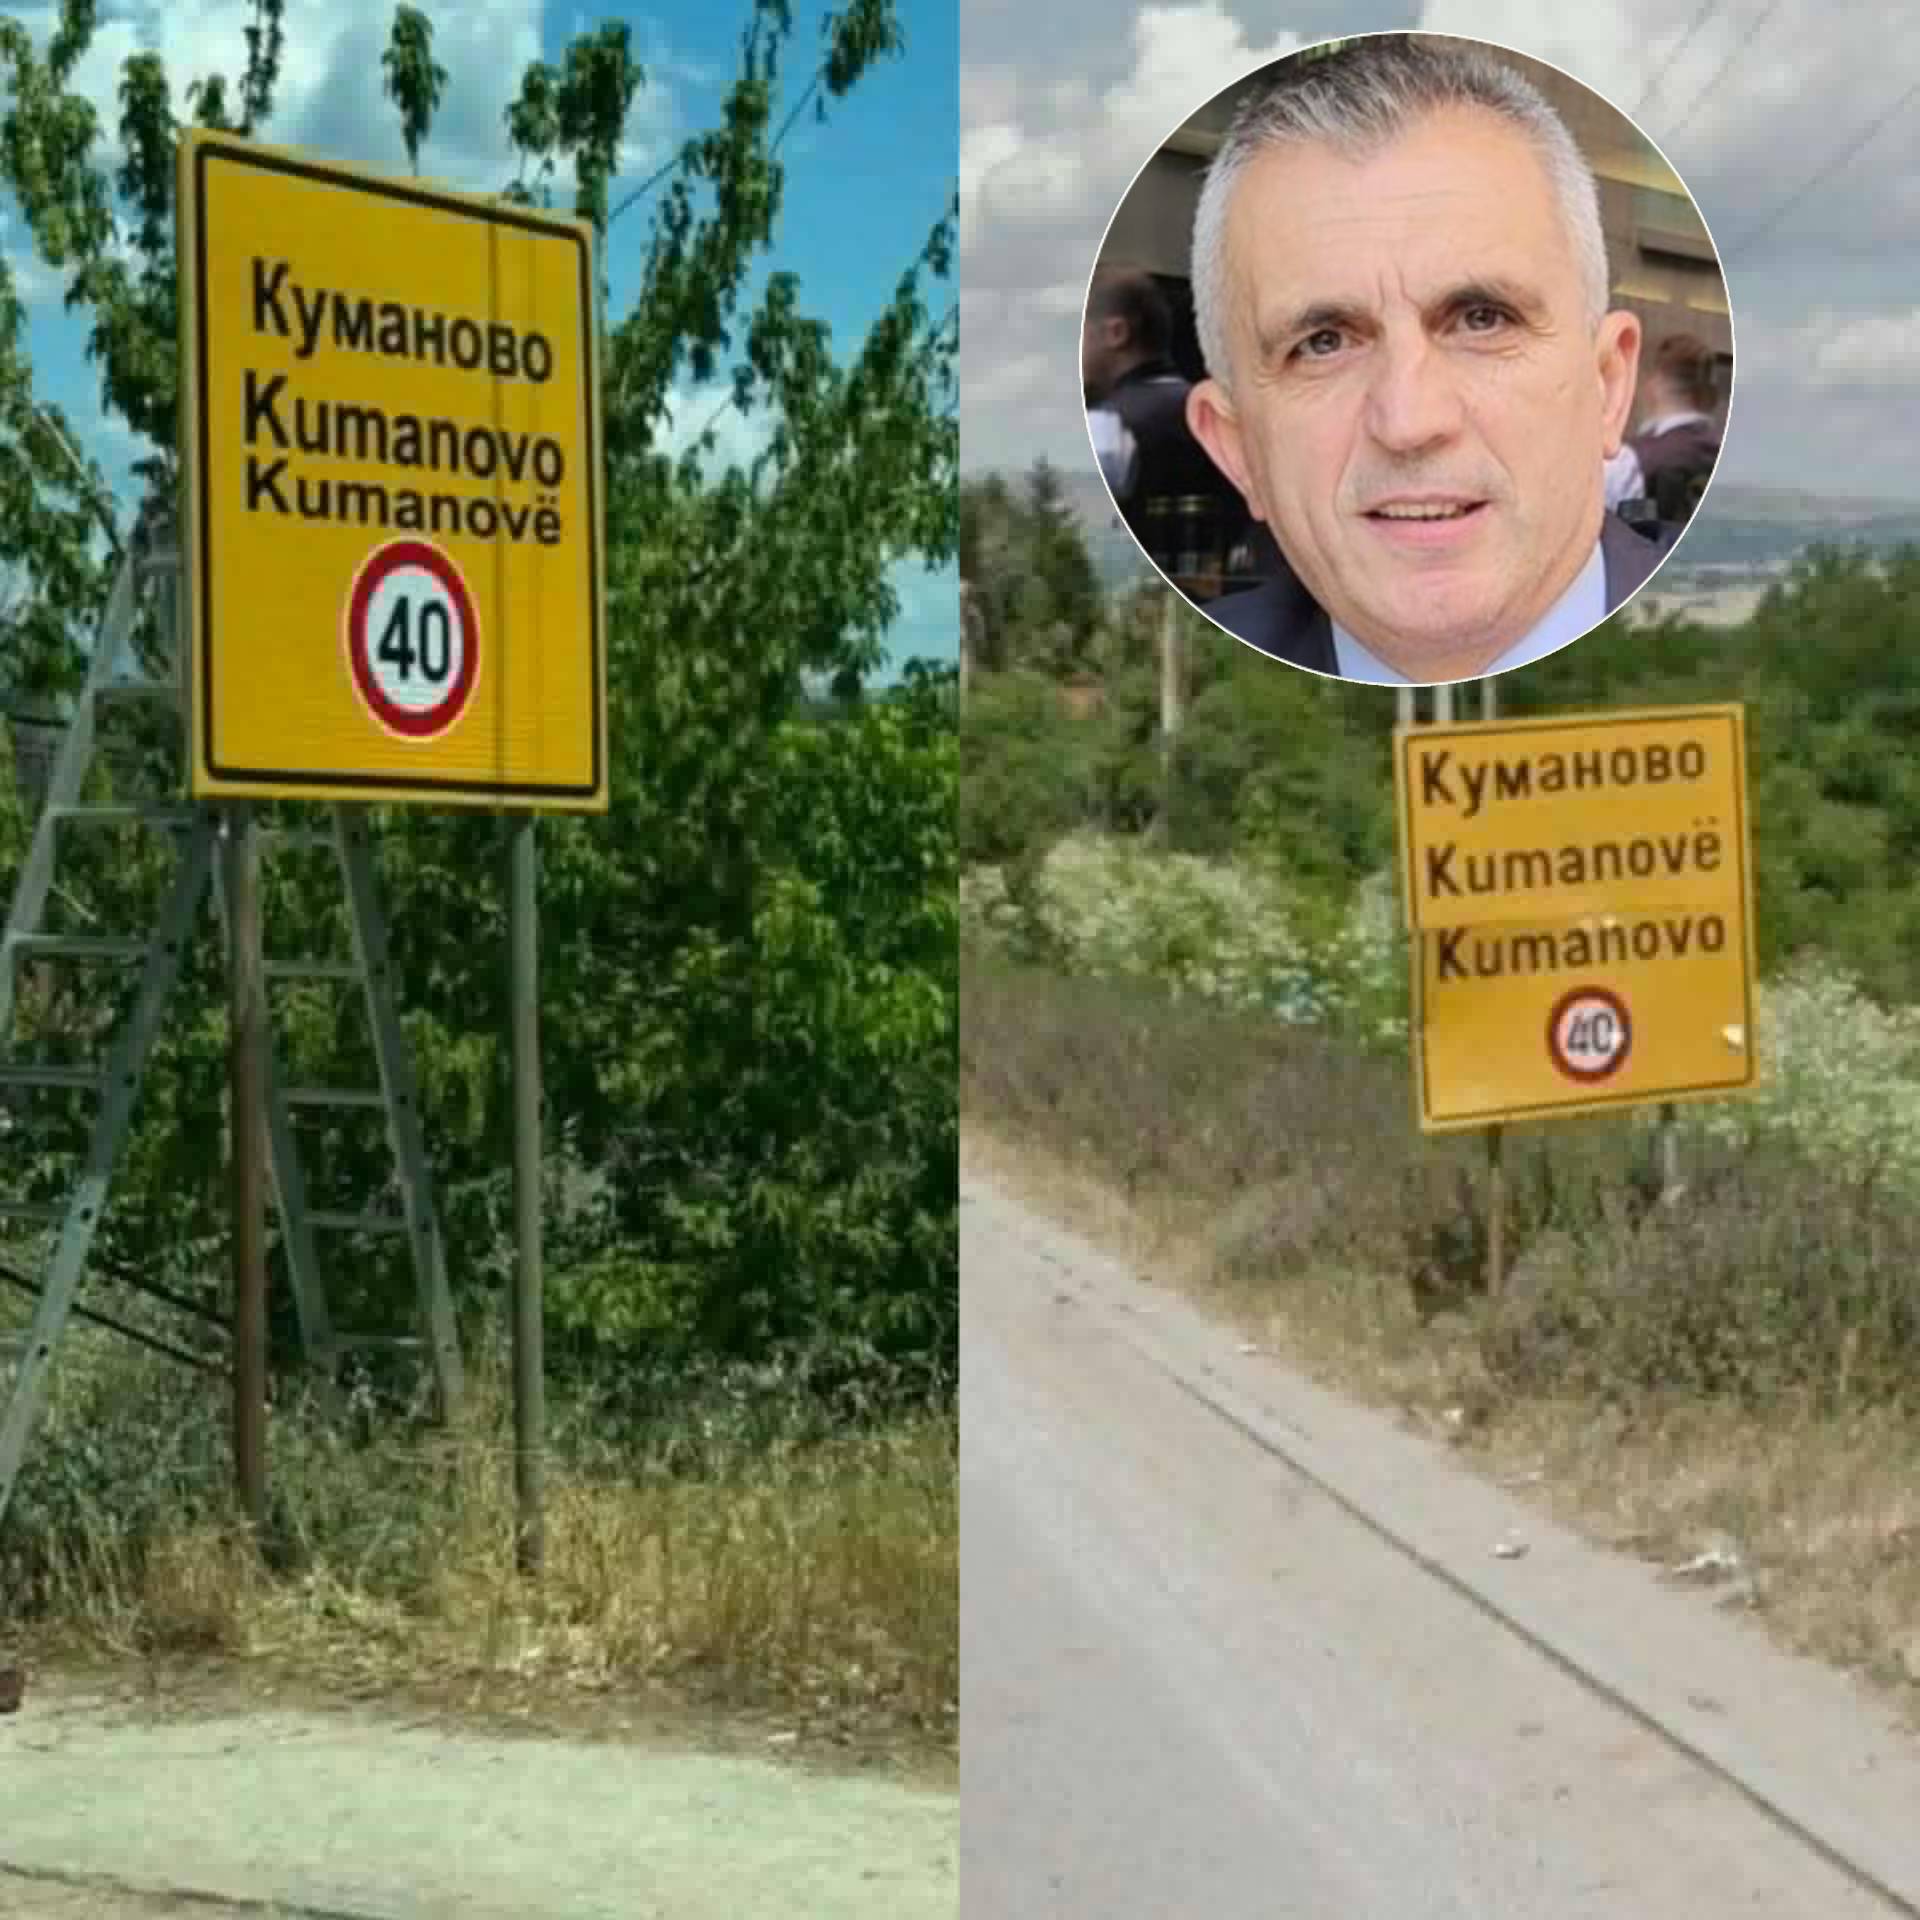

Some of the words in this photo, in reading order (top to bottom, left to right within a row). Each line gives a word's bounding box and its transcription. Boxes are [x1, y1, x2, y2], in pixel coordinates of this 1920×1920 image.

[251, 257, 552, 383] Куманово
[243, 369, 564, 489] Kumanovo
[244, 456, 561, 545] Kumanovë
[377, 595, 451, 682] 40
[1421, 742, 1705, 818] Куманово
[1426, 817, 1722, 898] Kumanovë
[1437, 914, 1726, 981] Kumanovo
[1566, 1011, 1614, 1056] 40
